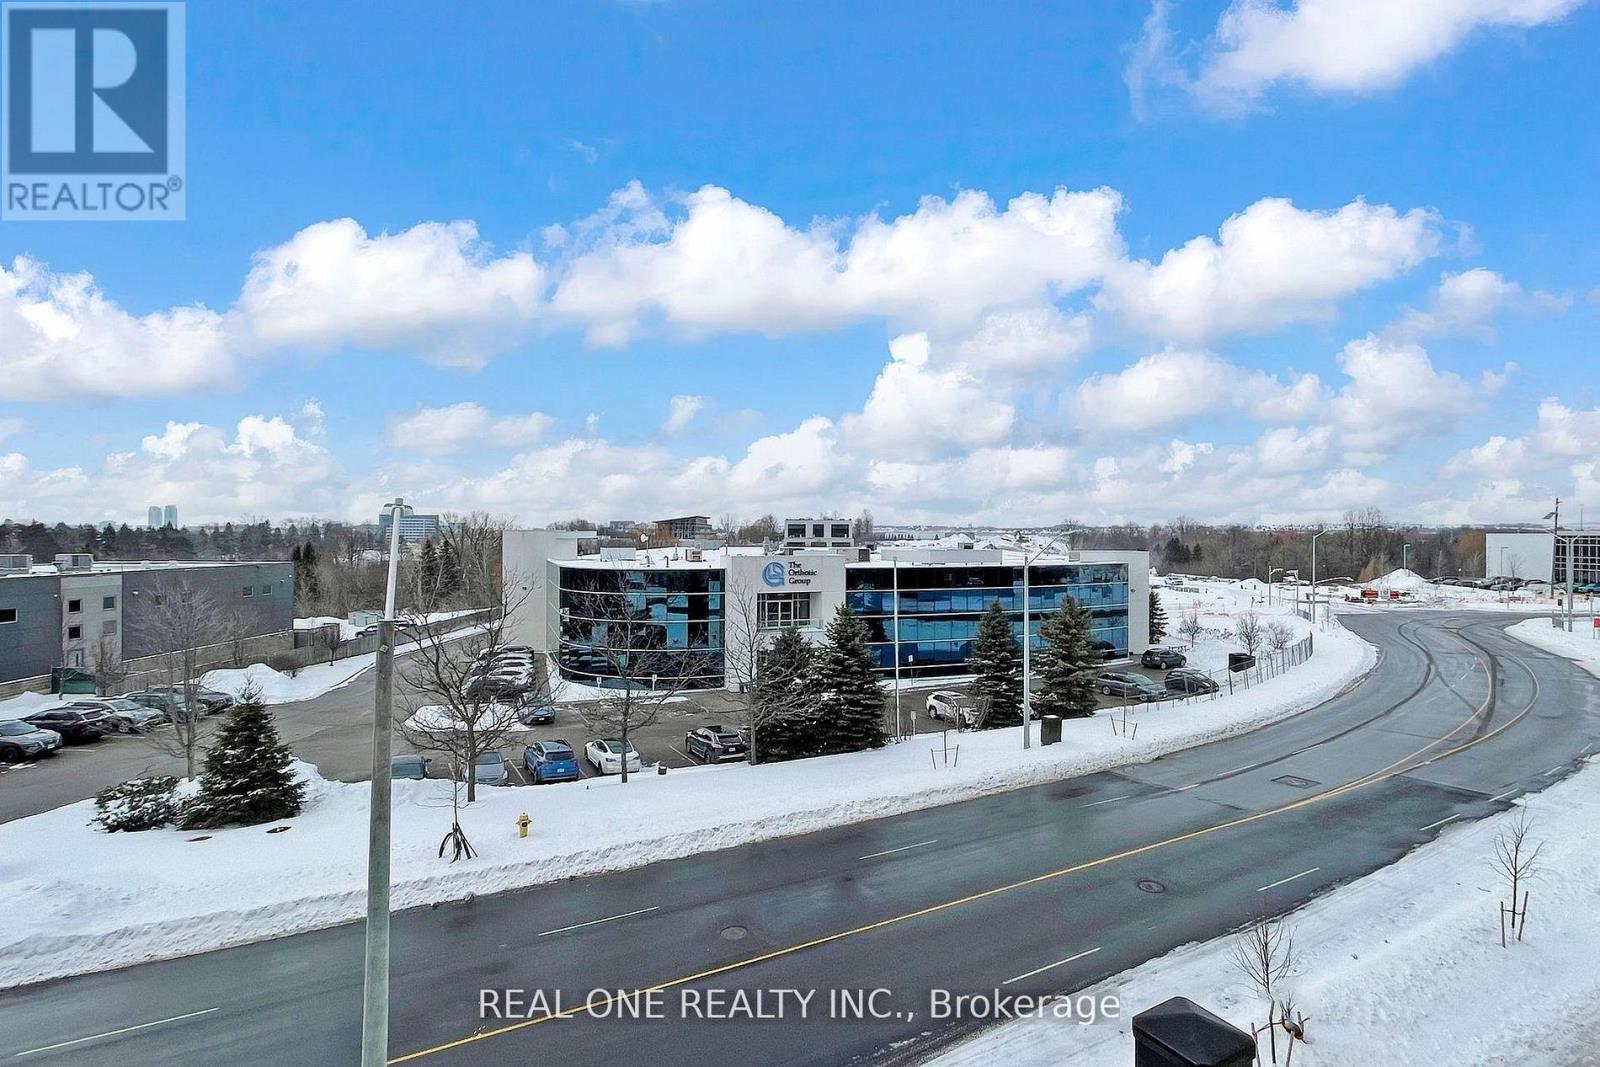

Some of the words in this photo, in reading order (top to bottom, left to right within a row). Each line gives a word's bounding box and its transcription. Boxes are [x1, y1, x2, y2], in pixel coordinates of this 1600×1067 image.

[788, 560, 802, 569] The
[788, 569, 818, 577] Orthotic
[788, 577, 812, 586] Group
